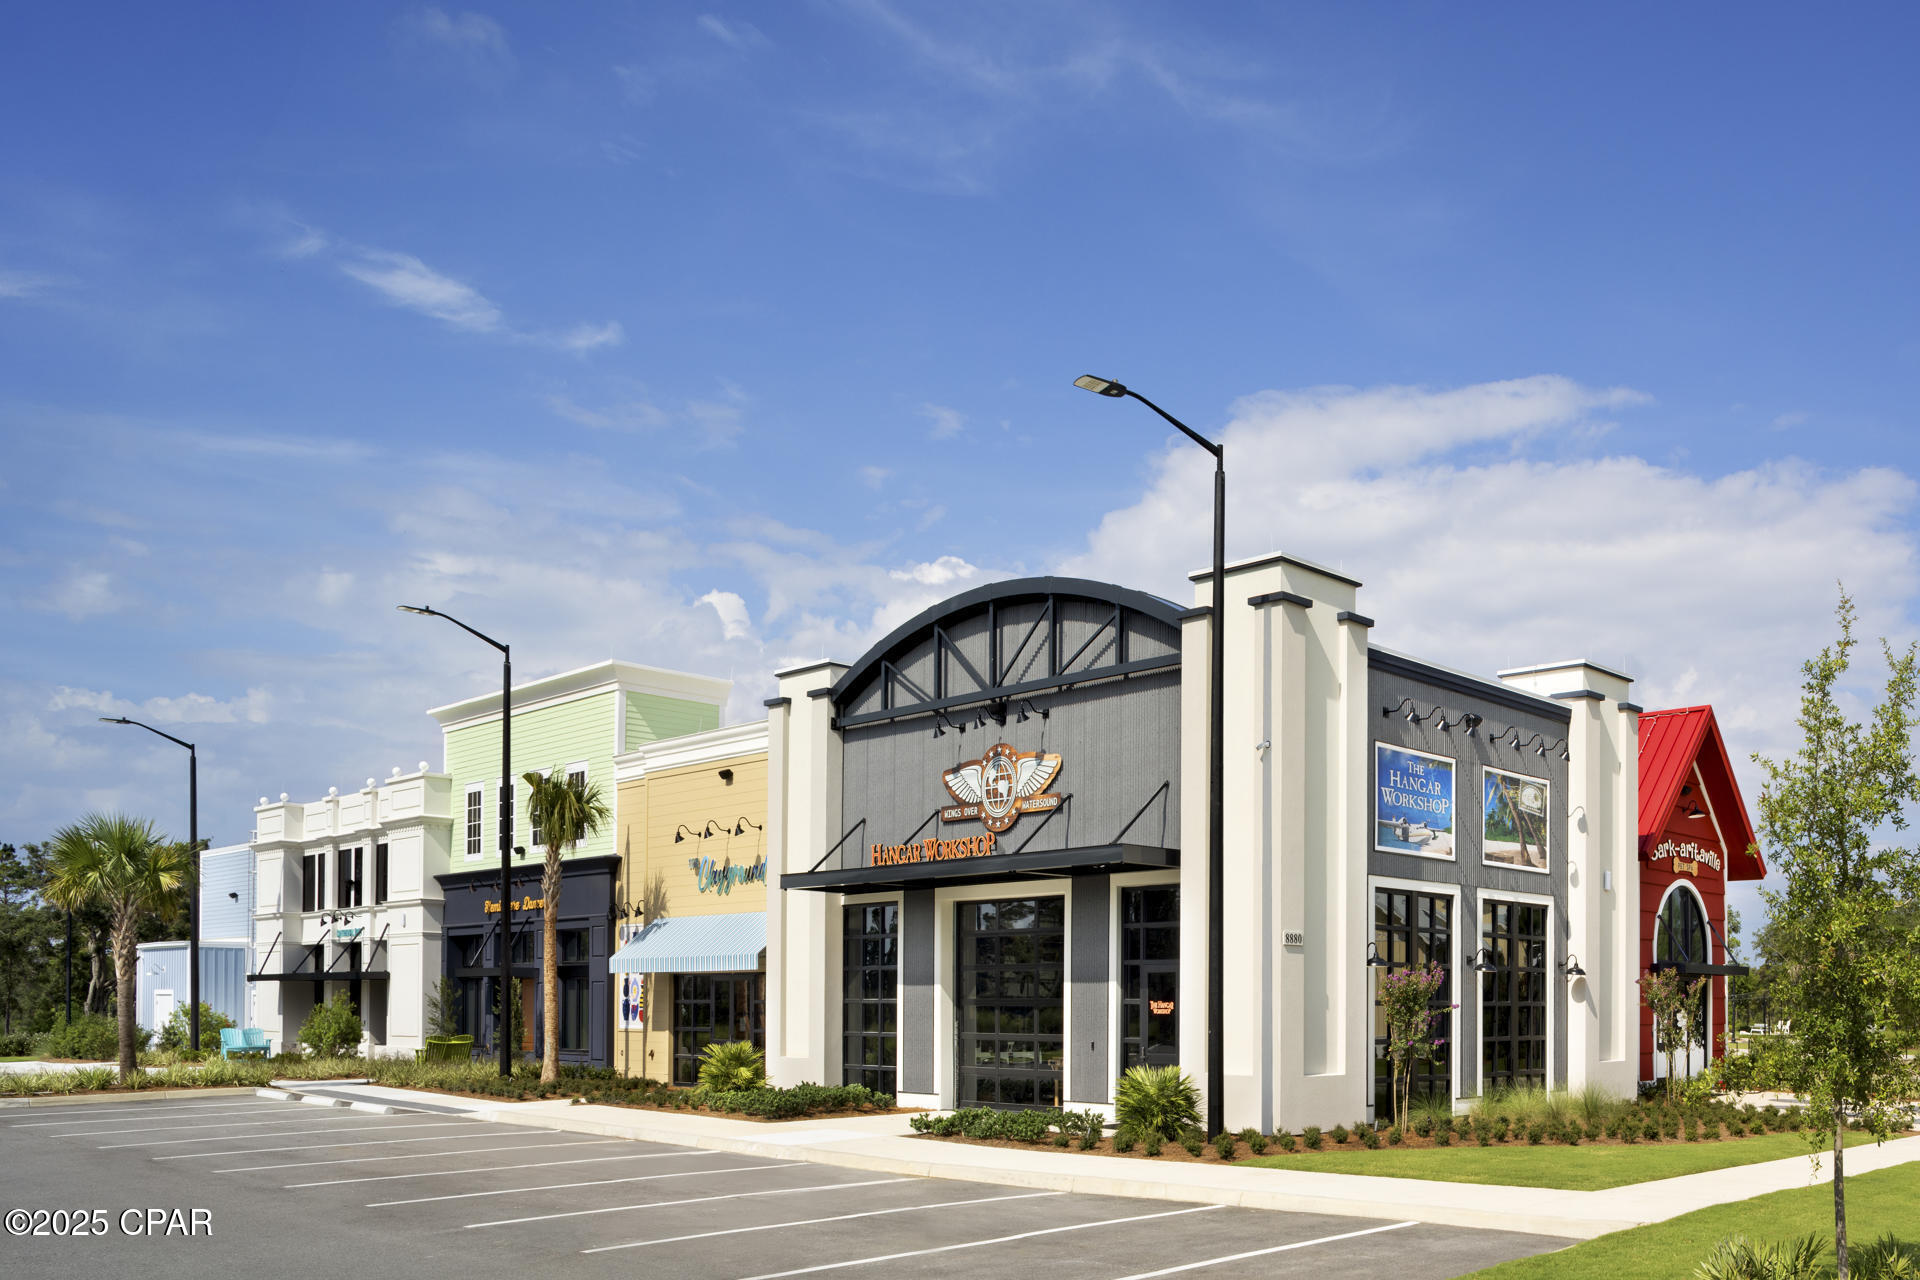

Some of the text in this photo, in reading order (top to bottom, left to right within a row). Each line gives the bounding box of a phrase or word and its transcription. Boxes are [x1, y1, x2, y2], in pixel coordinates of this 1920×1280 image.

[1407, 761, 1425, 776] THE
[1389, 769, 1441, 796] HANGAR
[944, 797, 1058, 819] WINGS OVER WATERSOUND
[1380, 786, 1449, 815] WORKSHOP
[870, 831, 996, 867] HANGAR WORKSHOP
[697, 855, 768, 897] Clayground
[1285, 933, 1303, 944] 8880
